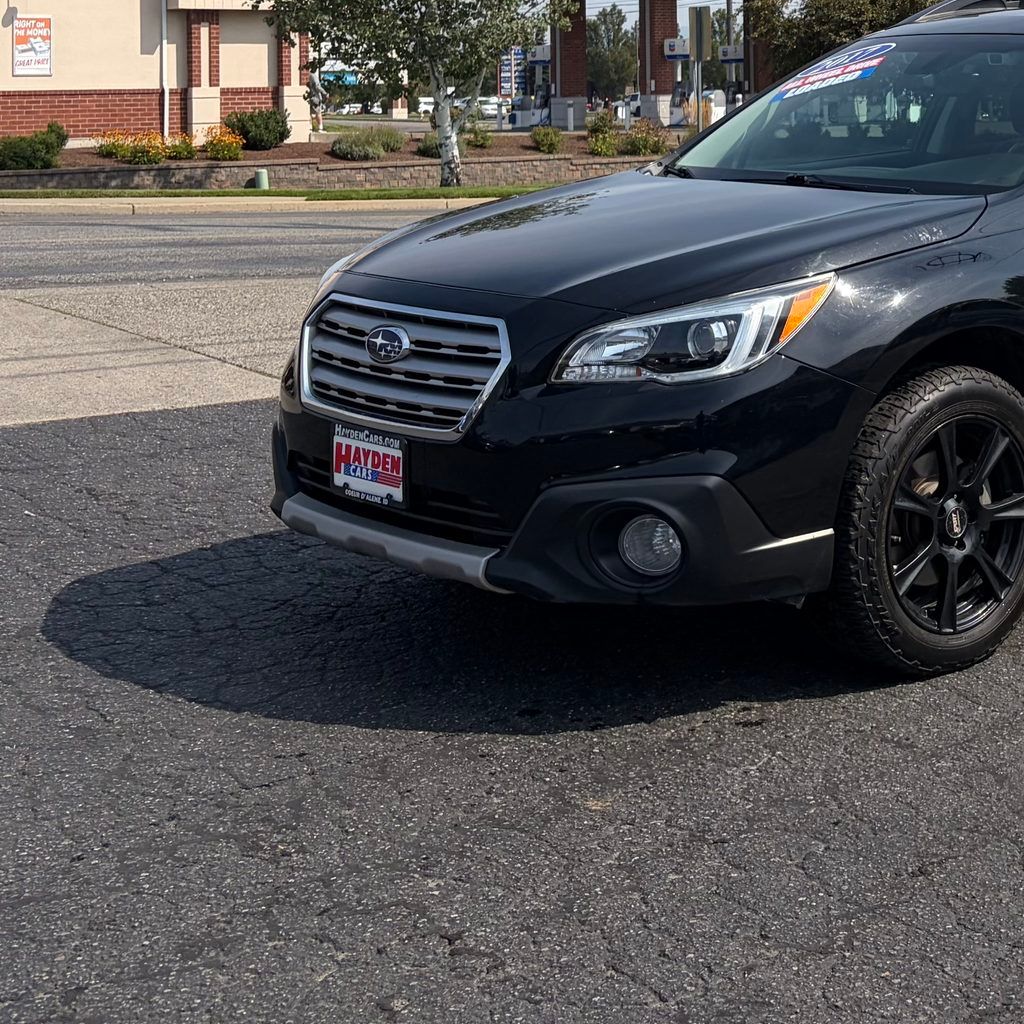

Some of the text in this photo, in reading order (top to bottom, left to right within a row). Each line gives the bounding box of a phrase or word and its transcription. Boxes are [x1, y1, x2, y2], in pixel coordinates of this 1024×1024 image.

[783, 71, 862, 99] LOADED
[335, 442, 401, 476] HAYDEN
[350, 465, 373, 480] CARS
